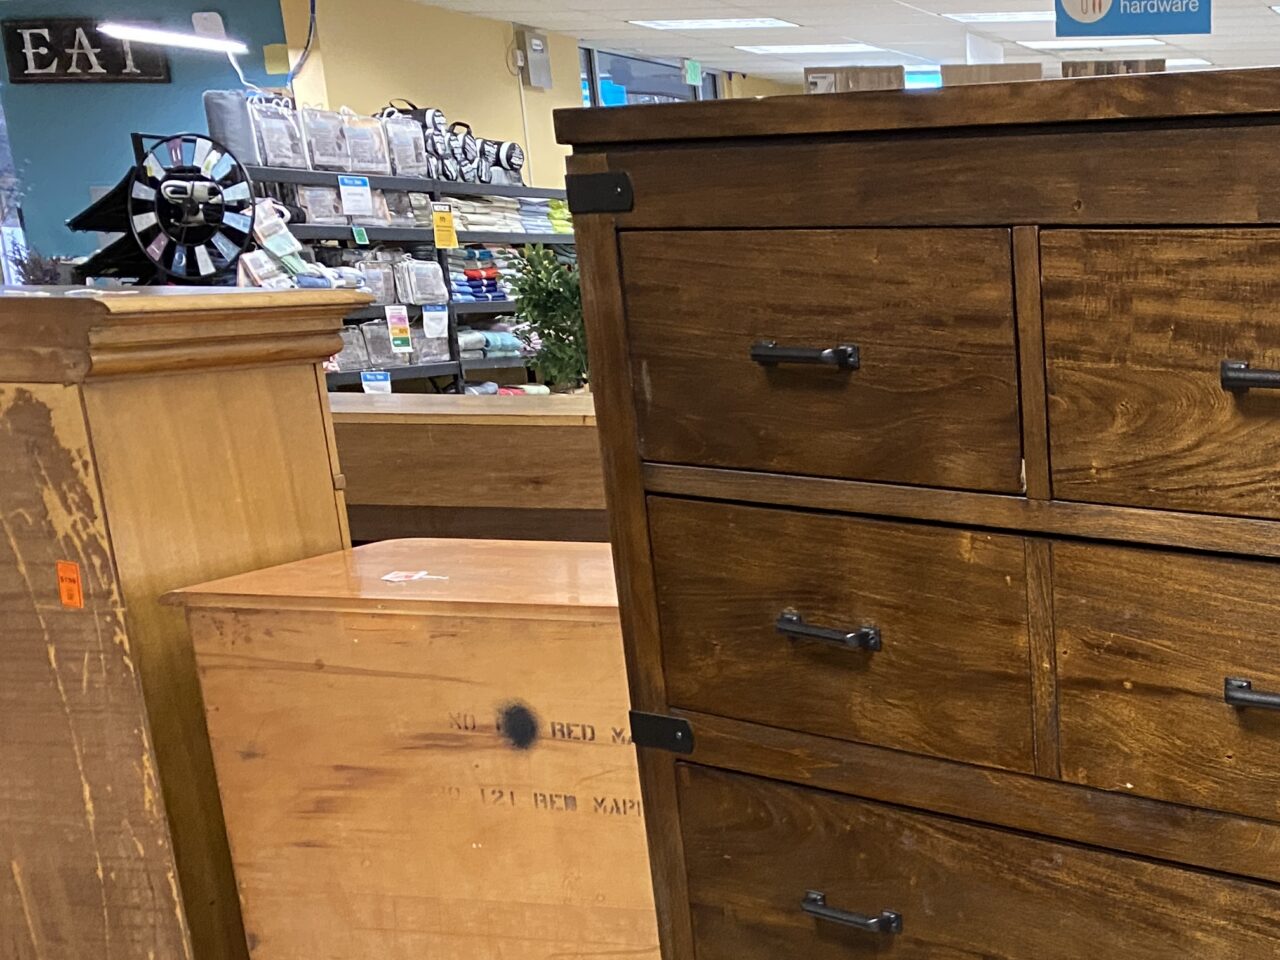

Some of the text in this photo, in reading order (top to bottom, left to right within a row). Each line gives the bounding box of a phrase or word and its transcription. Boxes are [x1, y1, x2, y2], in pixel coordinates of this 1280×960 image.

[1119, 0, 1200, 15] hardware
[550, 721, 596, 742] RED
[480, 787, 515, 807] 121
